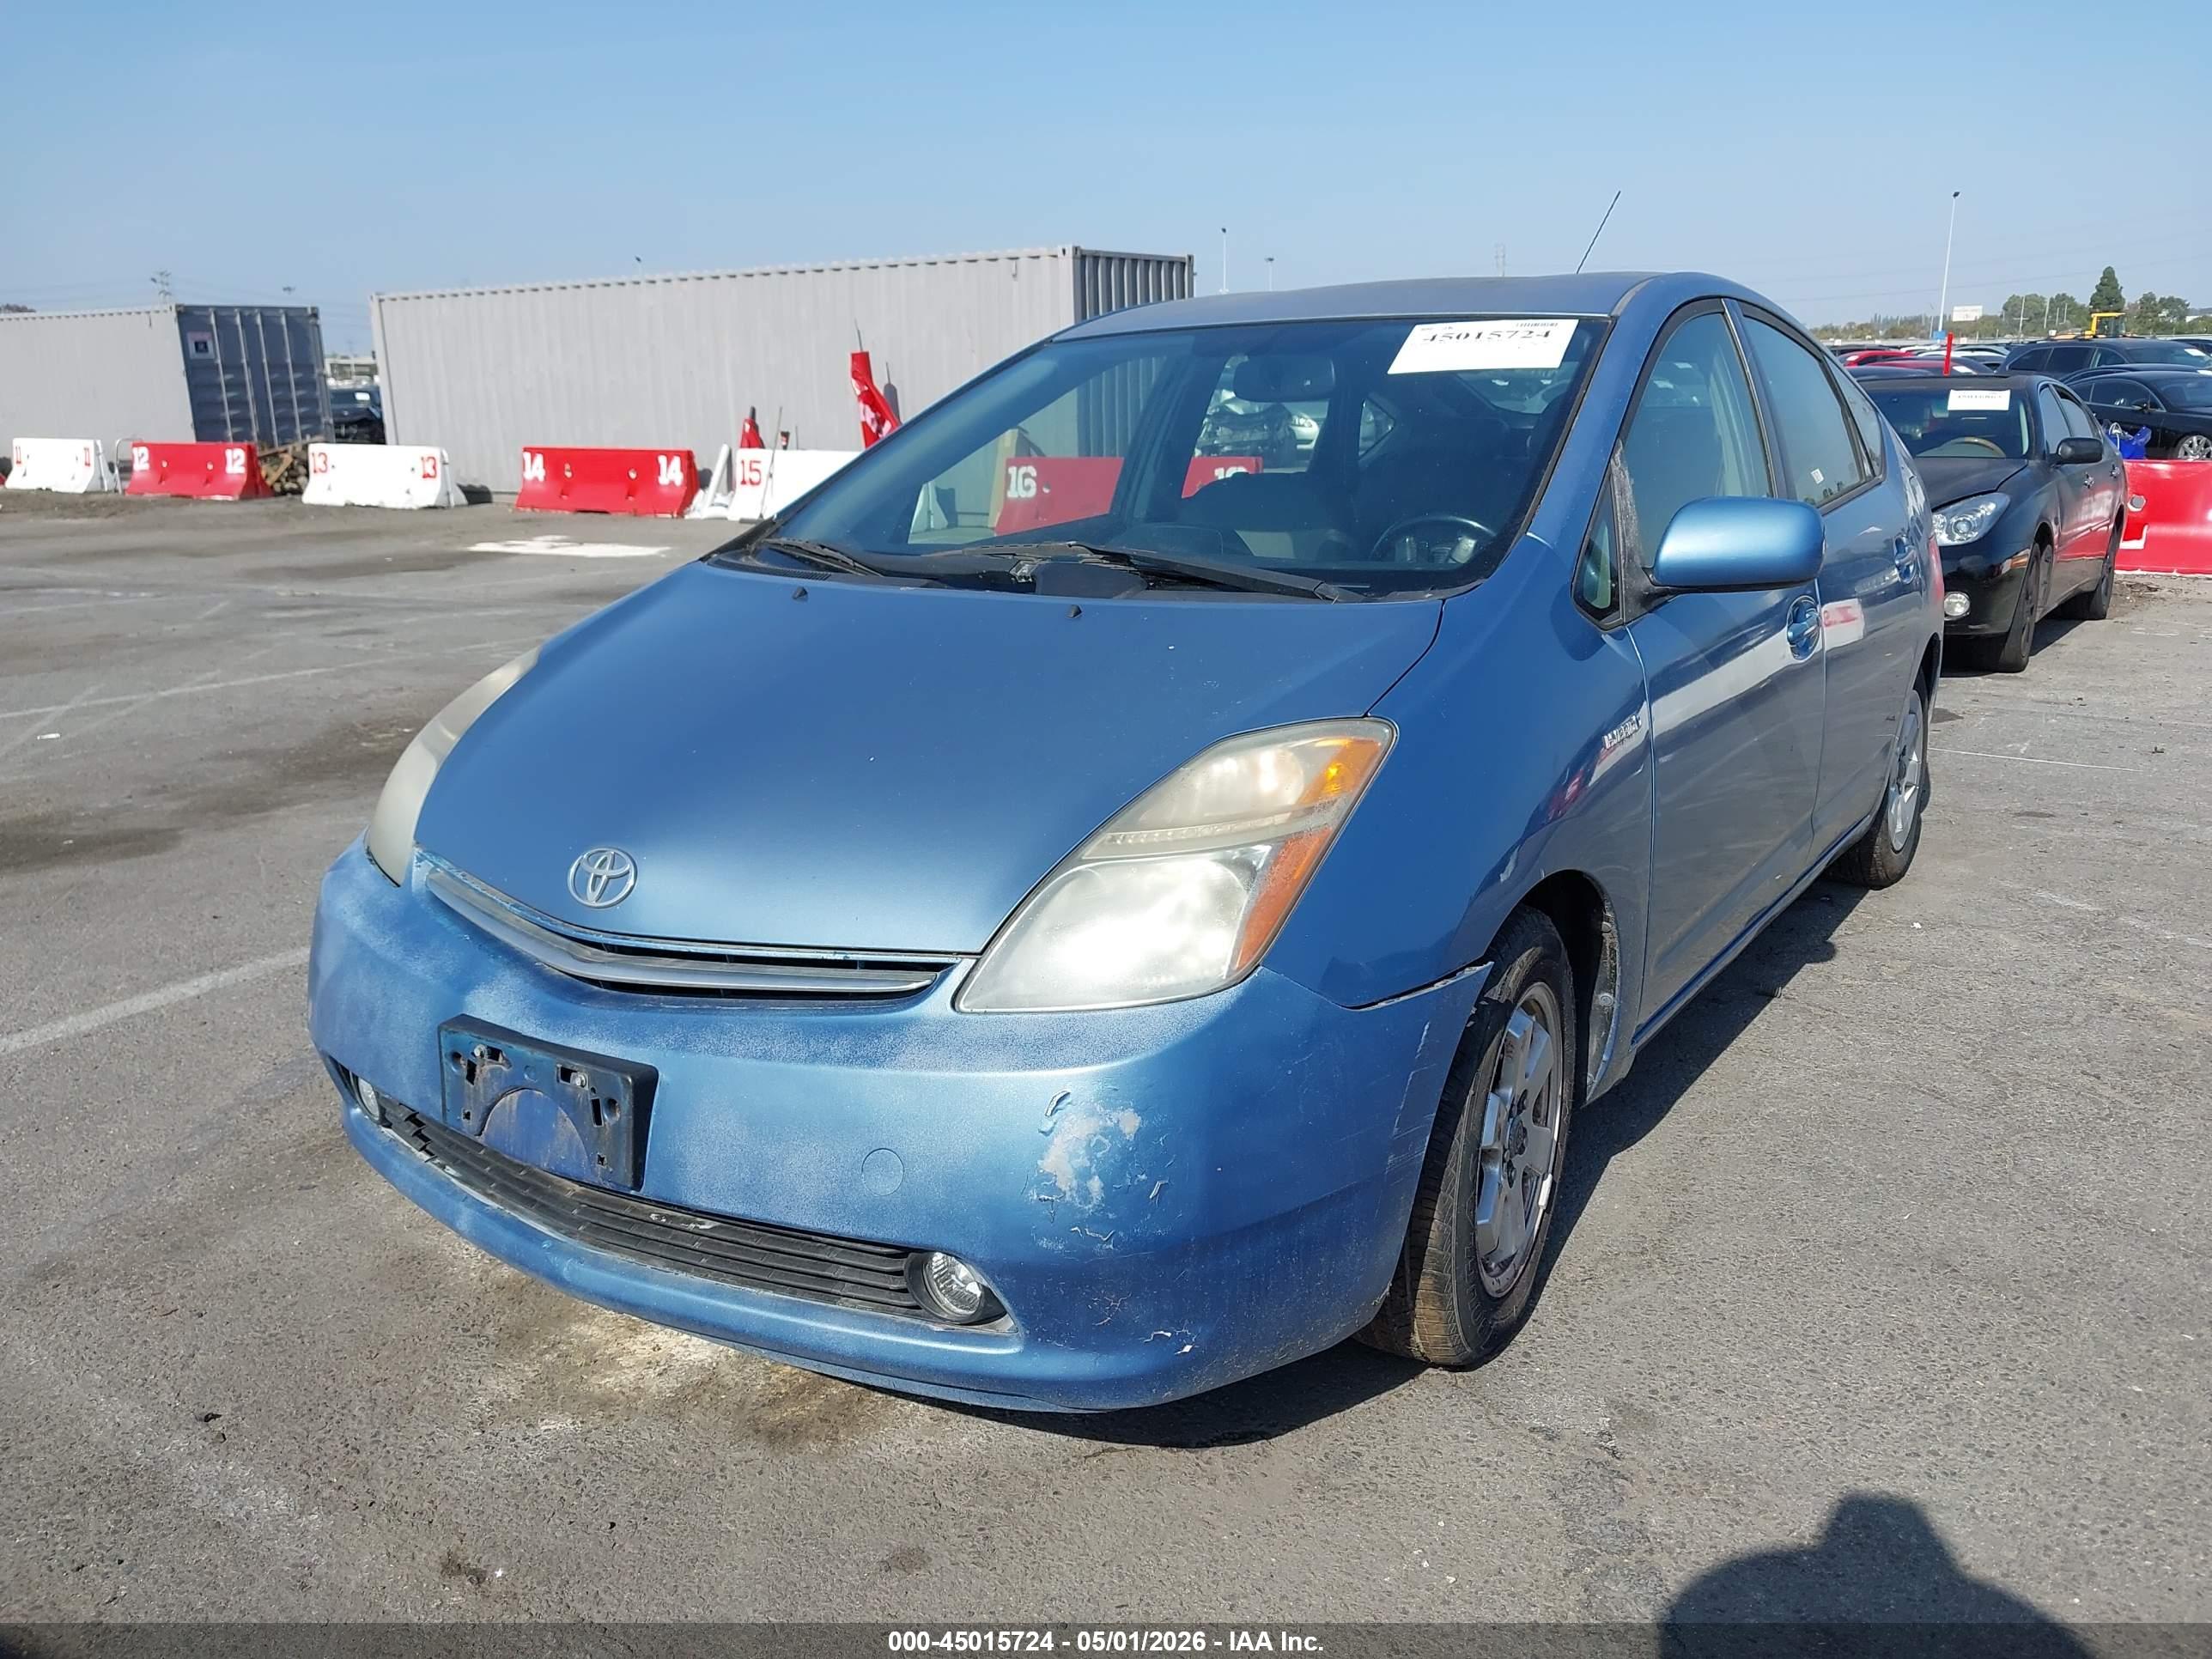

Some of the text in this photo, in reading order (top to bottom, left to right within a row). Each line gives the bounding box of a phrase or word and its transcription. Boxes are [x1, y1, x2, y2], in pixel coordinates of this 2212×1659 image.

[132, 446, 149, 471] 12
[225, 447, 246, 473] 12
[312, 452, 328, 473] 13
[421, 456, 437, 478] 13
[523, 452, 545, 482] 14
[658, 454, 684, 486] 14
[740, 459, 762, 486] 15
[1007, 465, 1037, 498] 16
